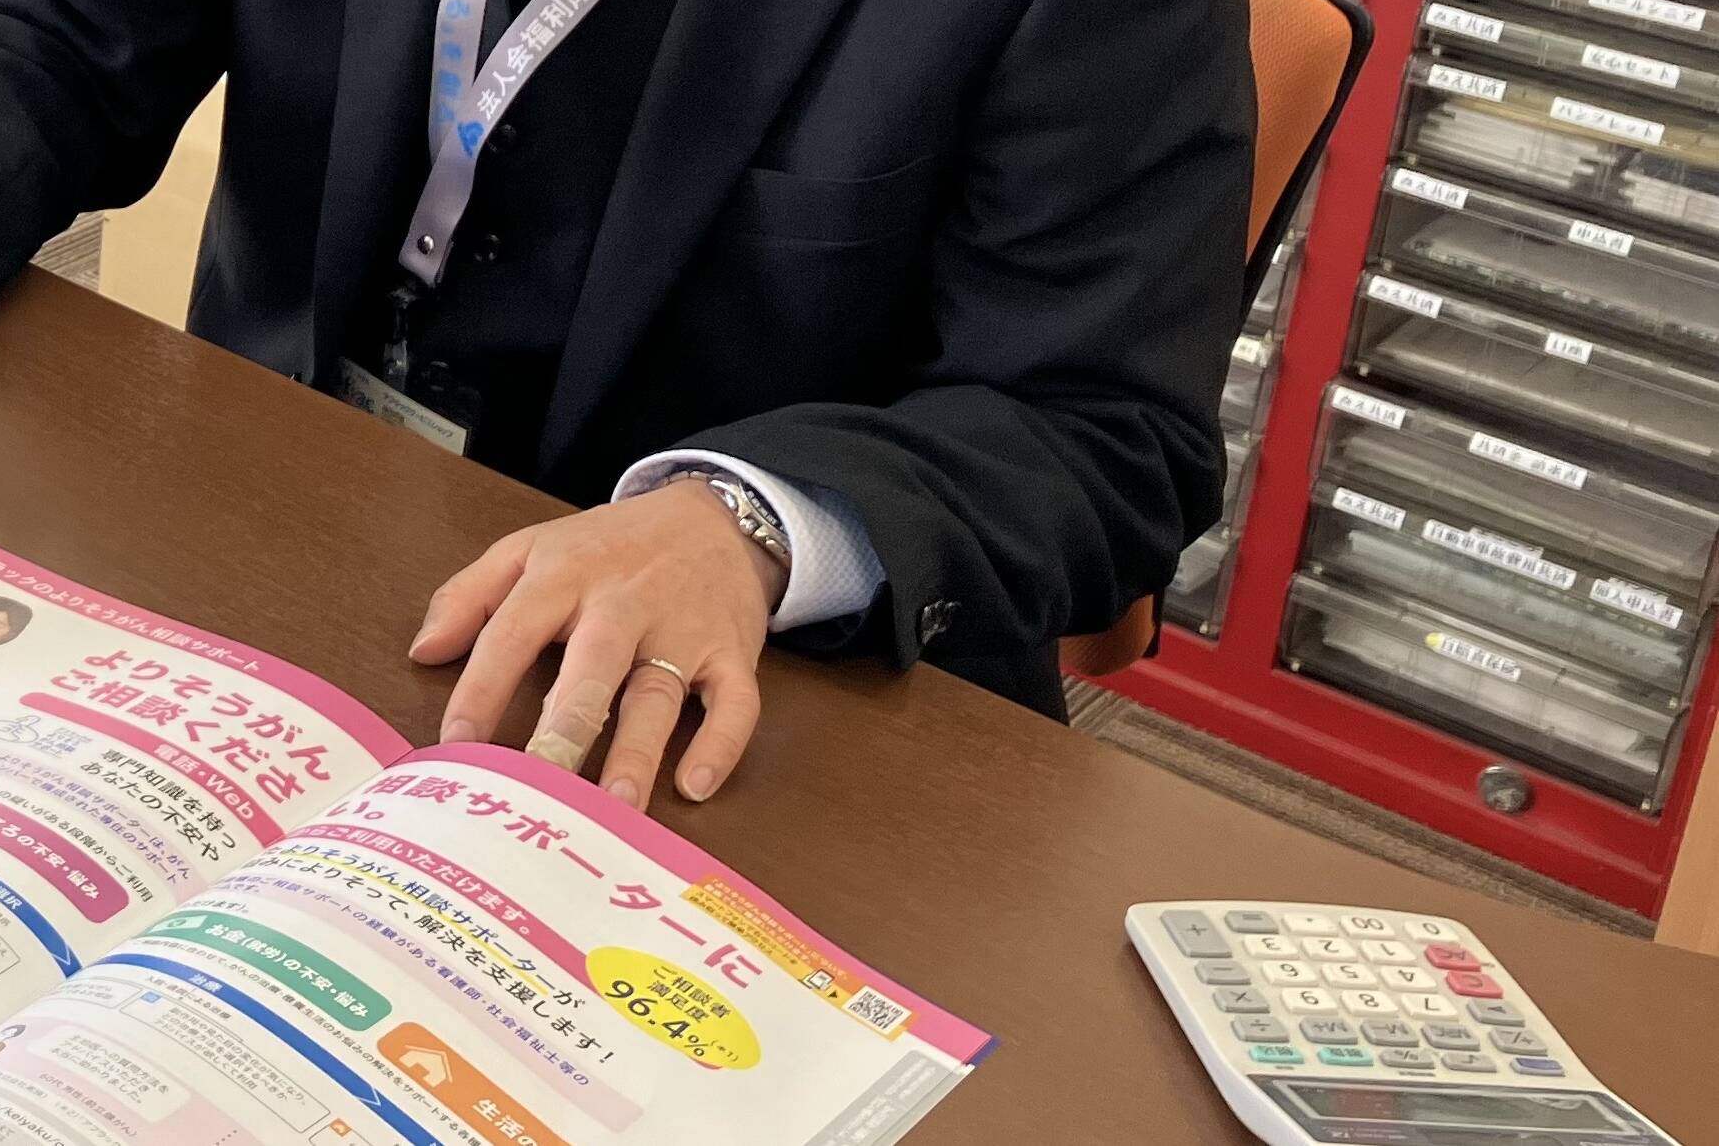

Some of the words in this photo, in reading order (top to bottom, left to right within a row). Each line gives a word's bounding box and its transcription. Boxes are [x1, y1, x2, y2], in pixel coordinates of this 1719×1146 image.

[50, 669, 307, 803] ご相談くださ
[83, 648, 333, 782] よりそうがん
[80, 758, 221, 863] あなたの不安や
[101, 748, 237, 850] 専門知識を持つ
[364, 774, 763, 990] 相談サポーターに
[652, 964, 733, 1021] ご相談者
